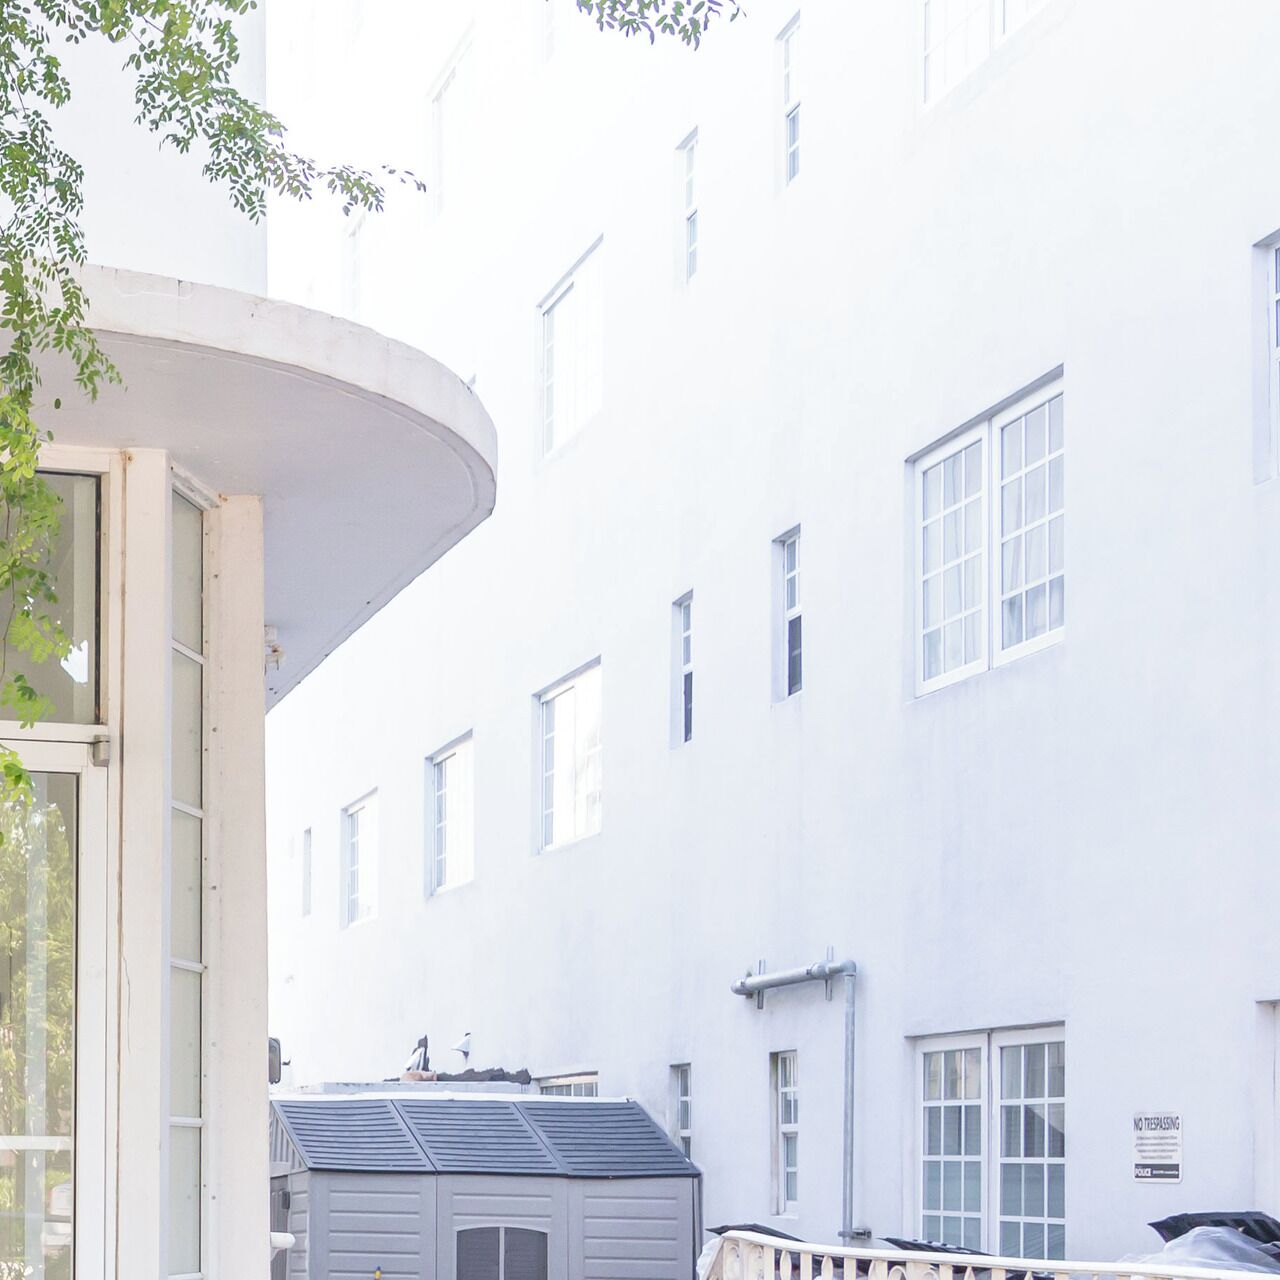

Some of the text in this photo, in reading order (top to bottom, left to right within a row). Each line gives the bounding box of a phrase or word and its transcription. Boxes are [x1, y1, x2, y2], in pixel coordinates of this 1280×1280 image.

[1133, 1116, 1180, 1131] NO TRESPASSING
[1135, 1168, 1152, 1177] POLICE
